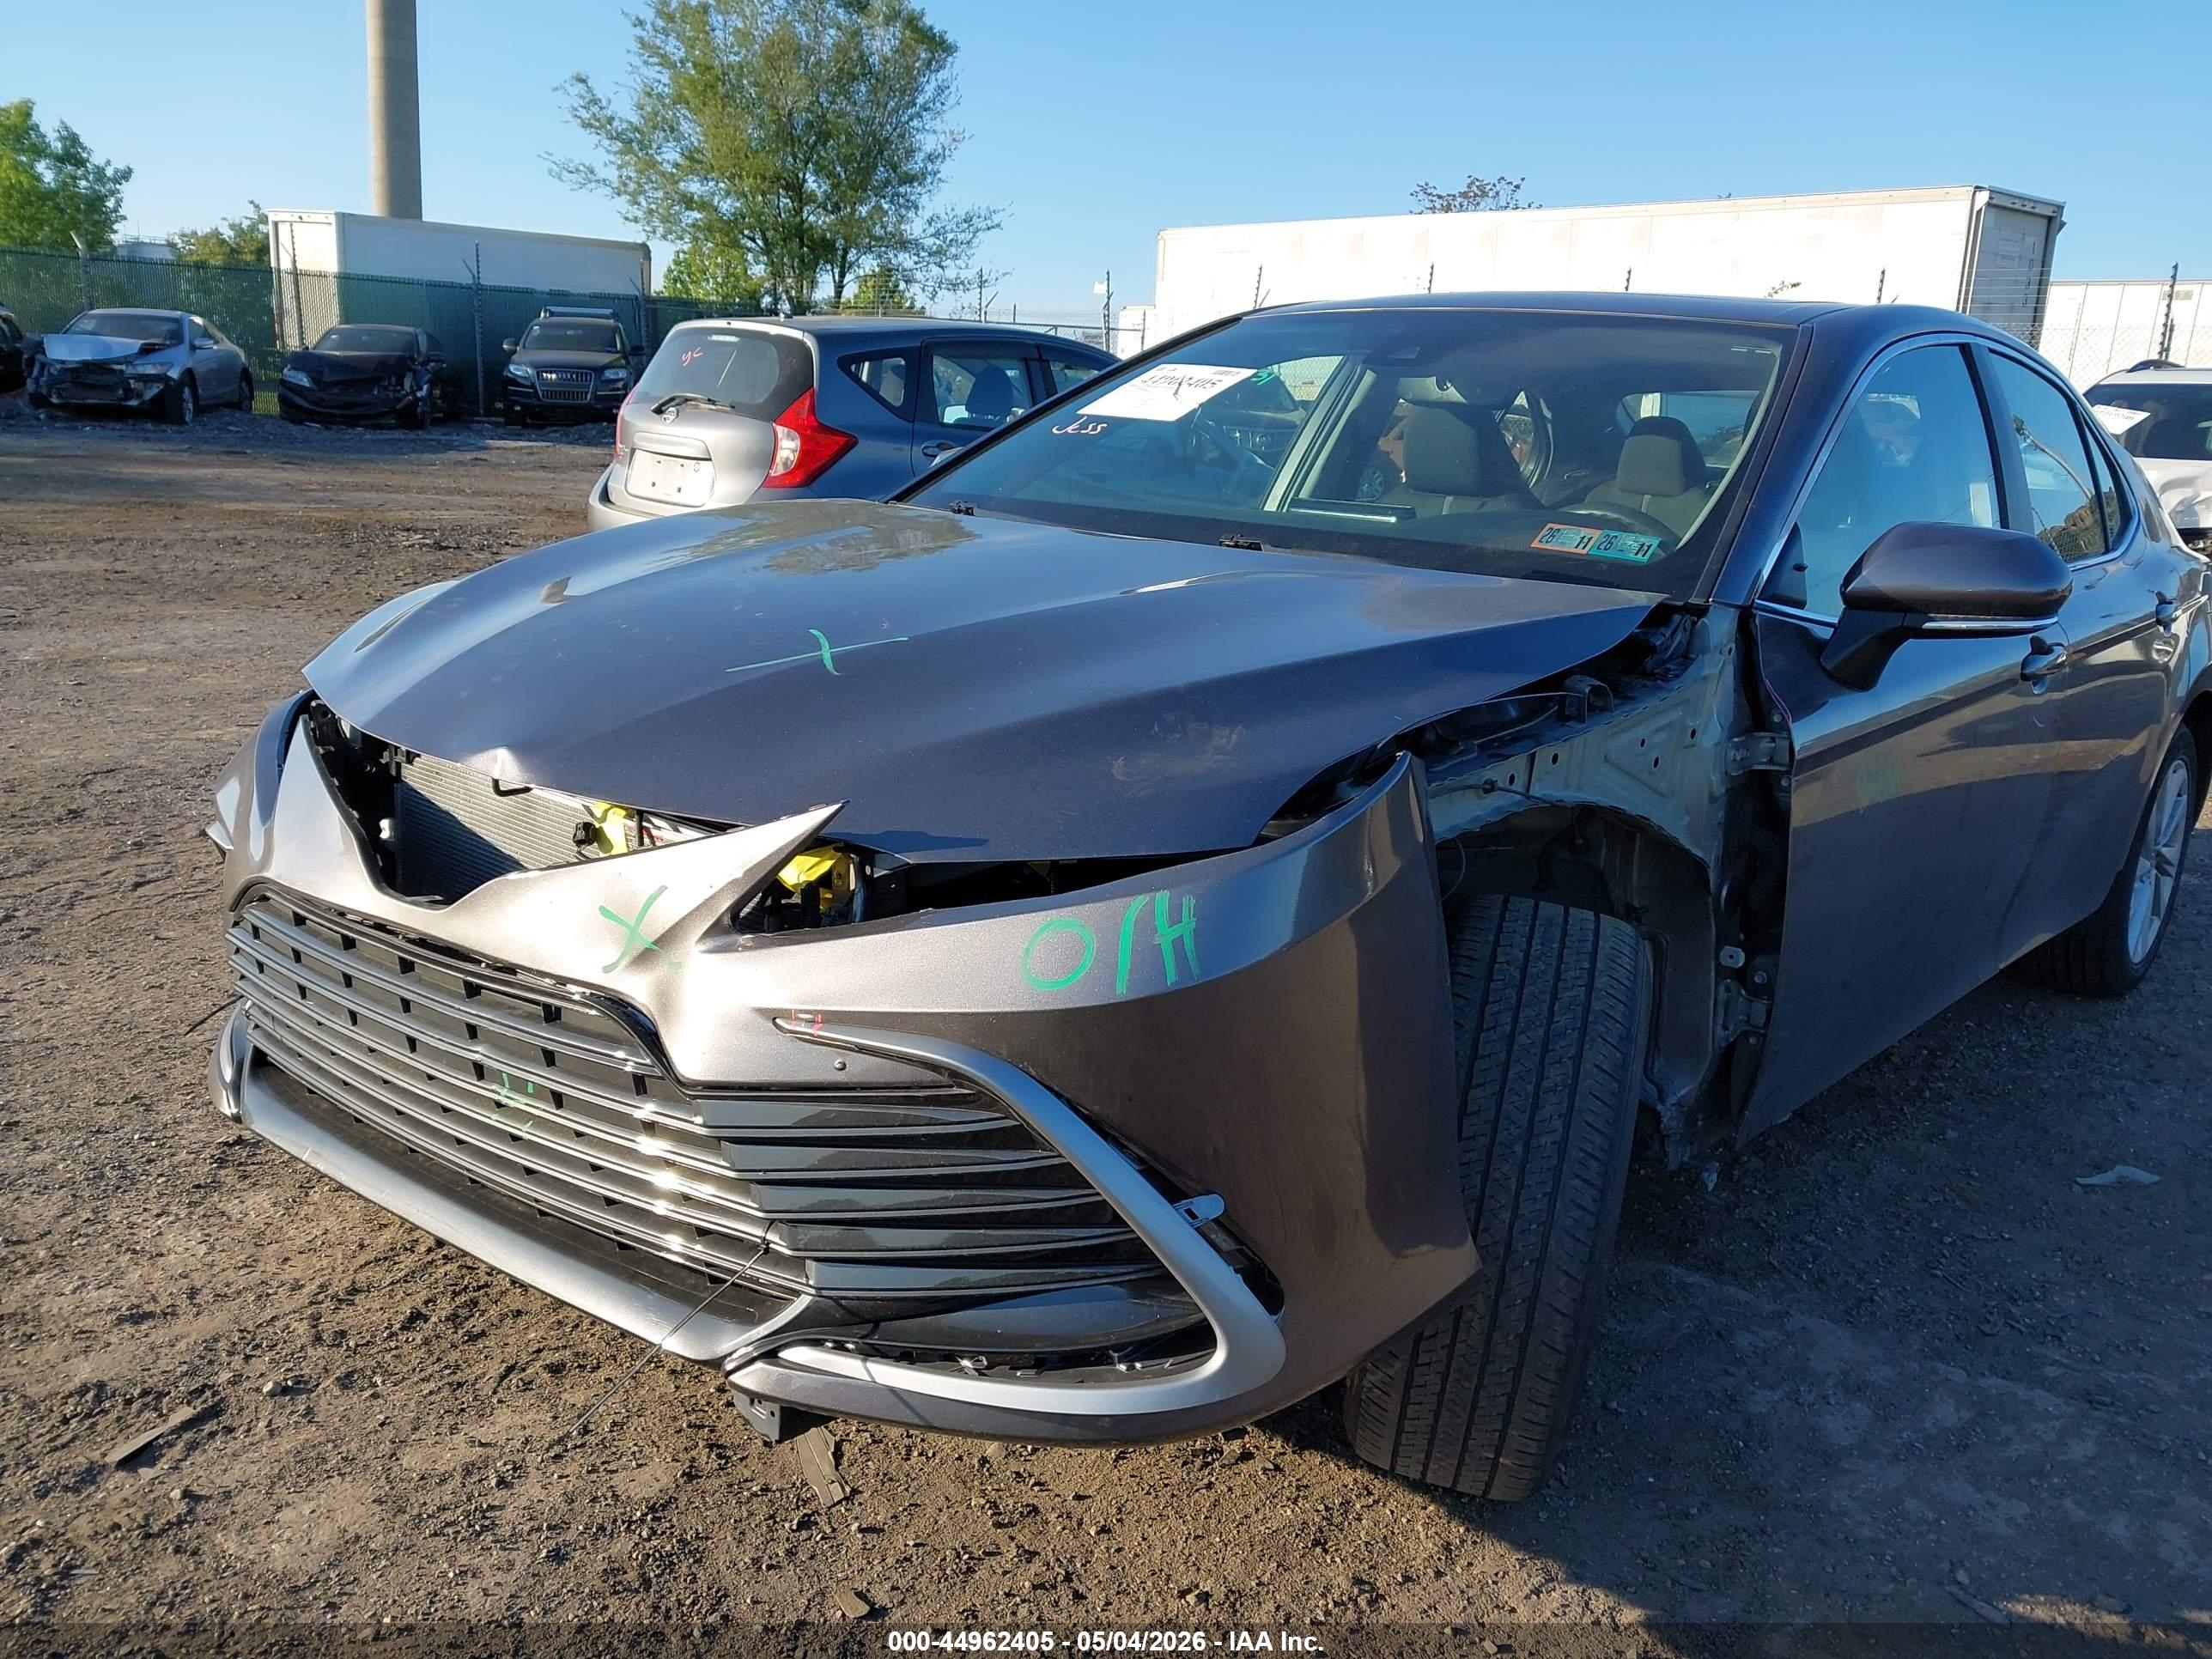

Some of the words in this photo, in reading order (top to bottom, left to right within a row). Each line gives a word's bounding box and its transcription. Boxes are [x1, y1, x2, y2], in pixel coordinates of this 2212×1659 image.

[1052, 416, 1108, 434] Jess
[1538, 527, 1559, 544] 26
[1575, 535, 1594, 550] 11
[1596, 534, 1618, 551] 26
[1634, 543, 1653, 558] 11
